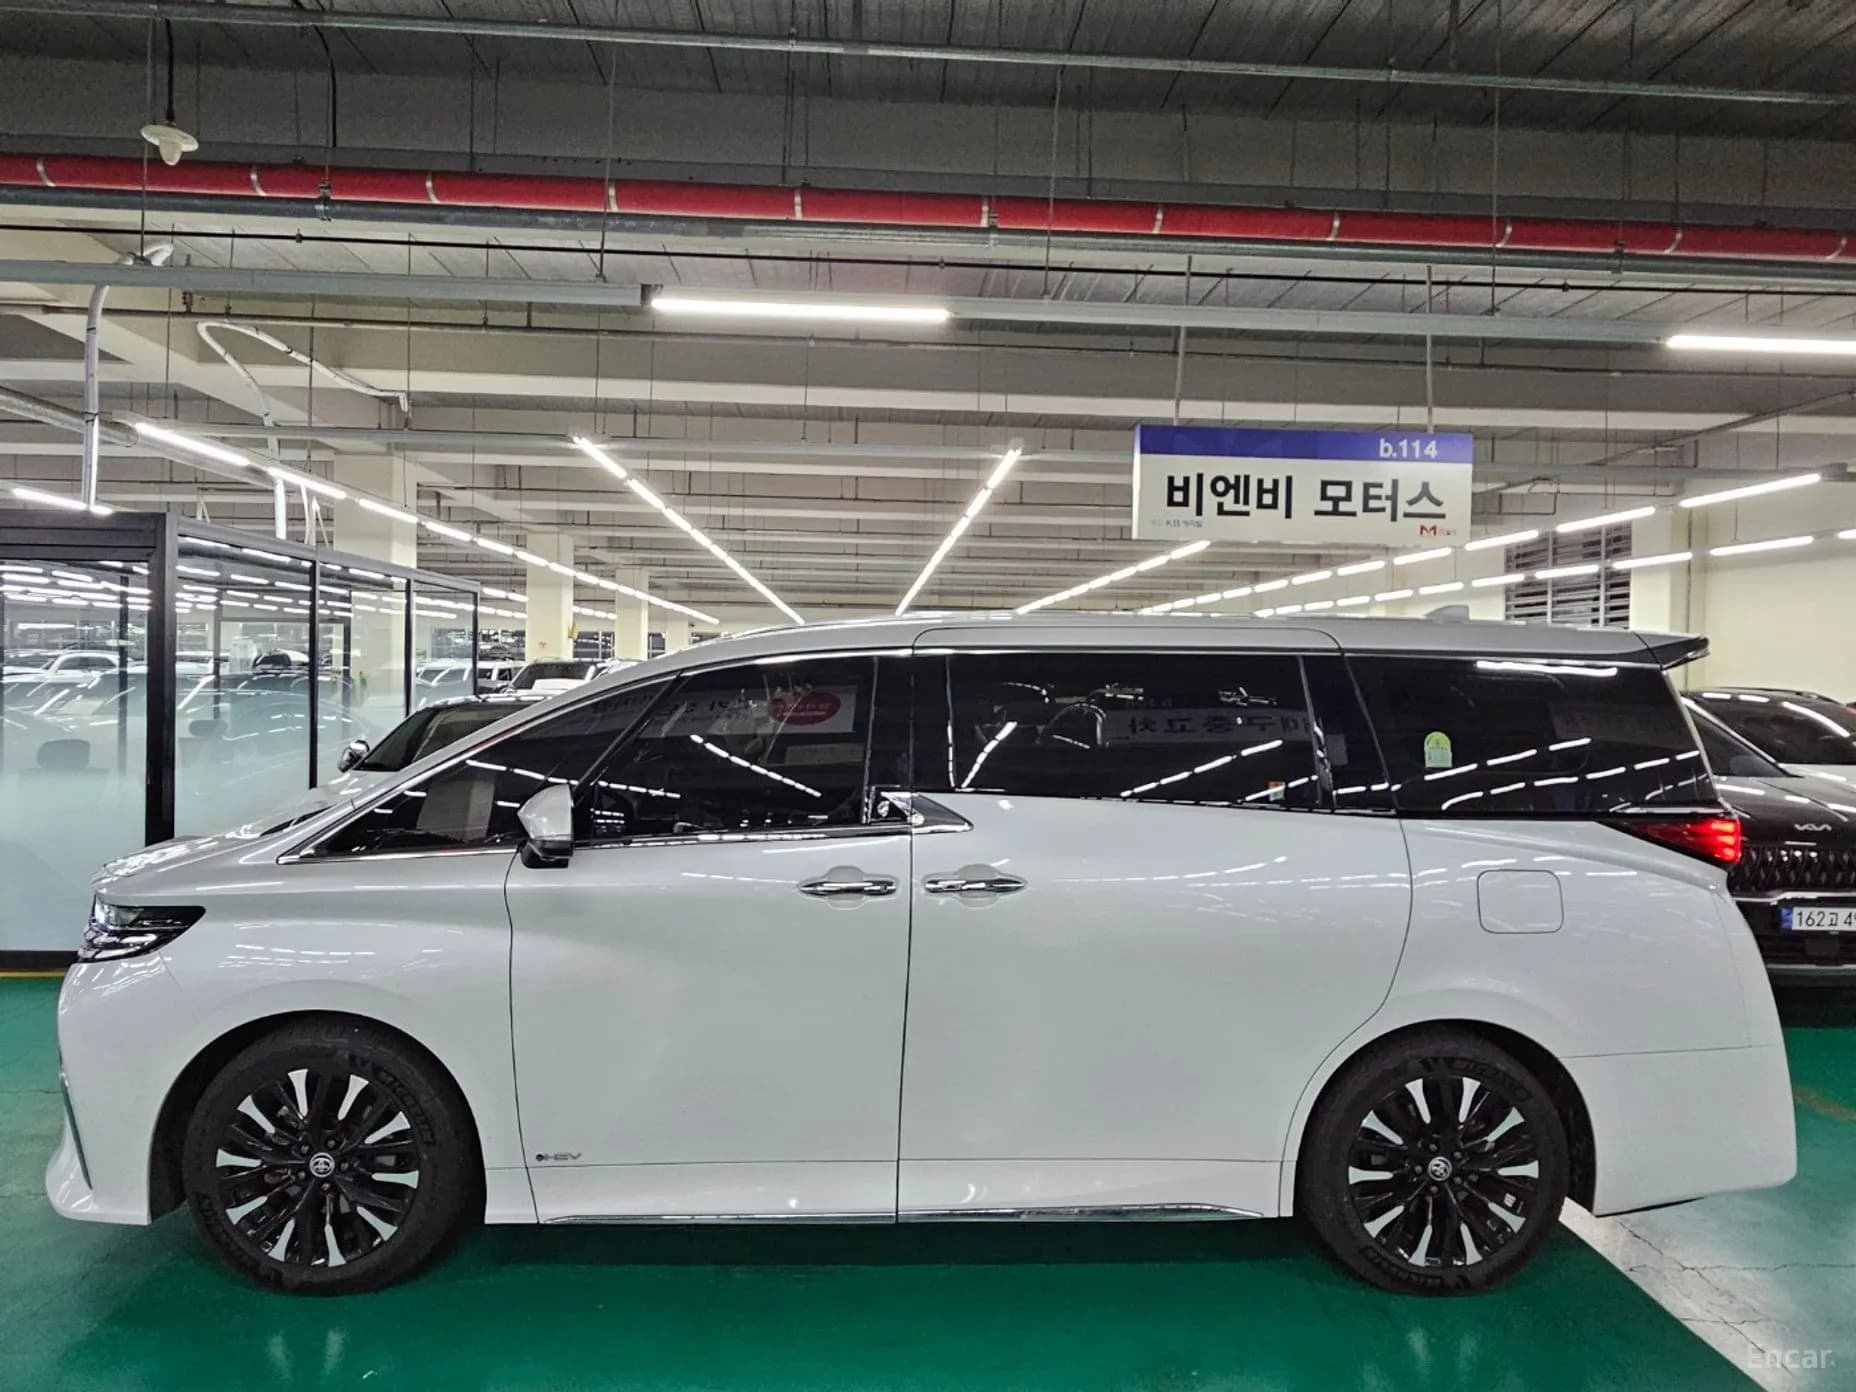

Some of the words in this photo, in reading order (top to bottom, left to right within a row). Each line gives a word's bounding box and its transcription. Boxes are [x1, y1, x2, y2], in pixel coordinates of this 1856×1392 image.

[1379, 437, 1439, 460] b.114
[1166, 472, 1293, 519] 비엔비
[1313, 478, 1447, 522] 모터스
